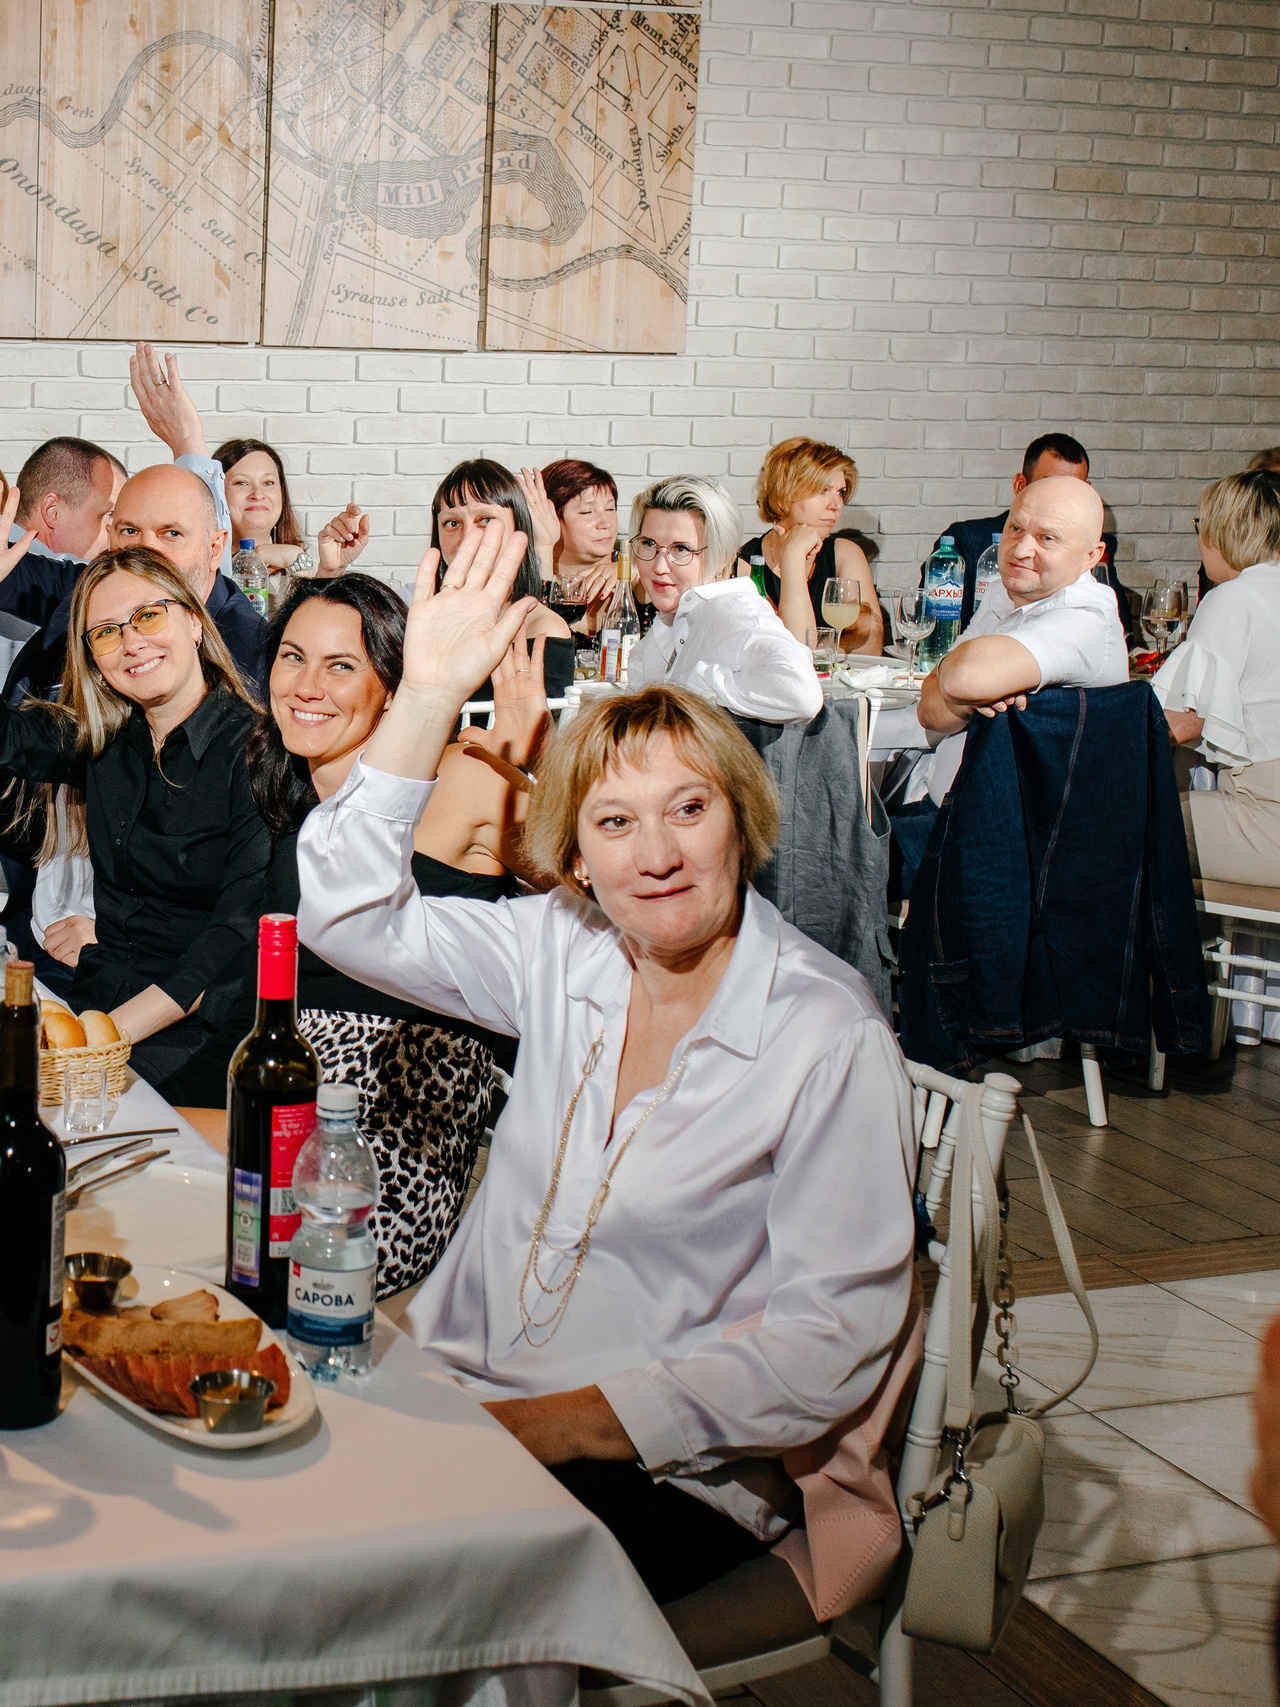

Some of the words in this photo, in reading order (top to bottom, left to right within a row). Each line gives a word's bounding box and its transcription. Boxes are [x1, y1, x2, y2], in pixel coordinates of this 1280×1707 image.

[544, 32, 587, 78] Warren
[58, 96, 94, 119] Creek
[575, 123, 614, 163] Salina
[656, 124, 685, 162] Sixth
[380, 183, 440, 207] Mill
[456, 149, 537, 185] Pond
[124, 155, 195, 216] Syracuse
[201, 218, 238, 250] Salt
[322, 225, 340, 266] Stores
[132, 265, 183, 308] Salt
[331, 282, 409, 308] Syracuse
[415, 289, 454, 308] Salt
[294, 1287, 355, 1307] САРОВА
